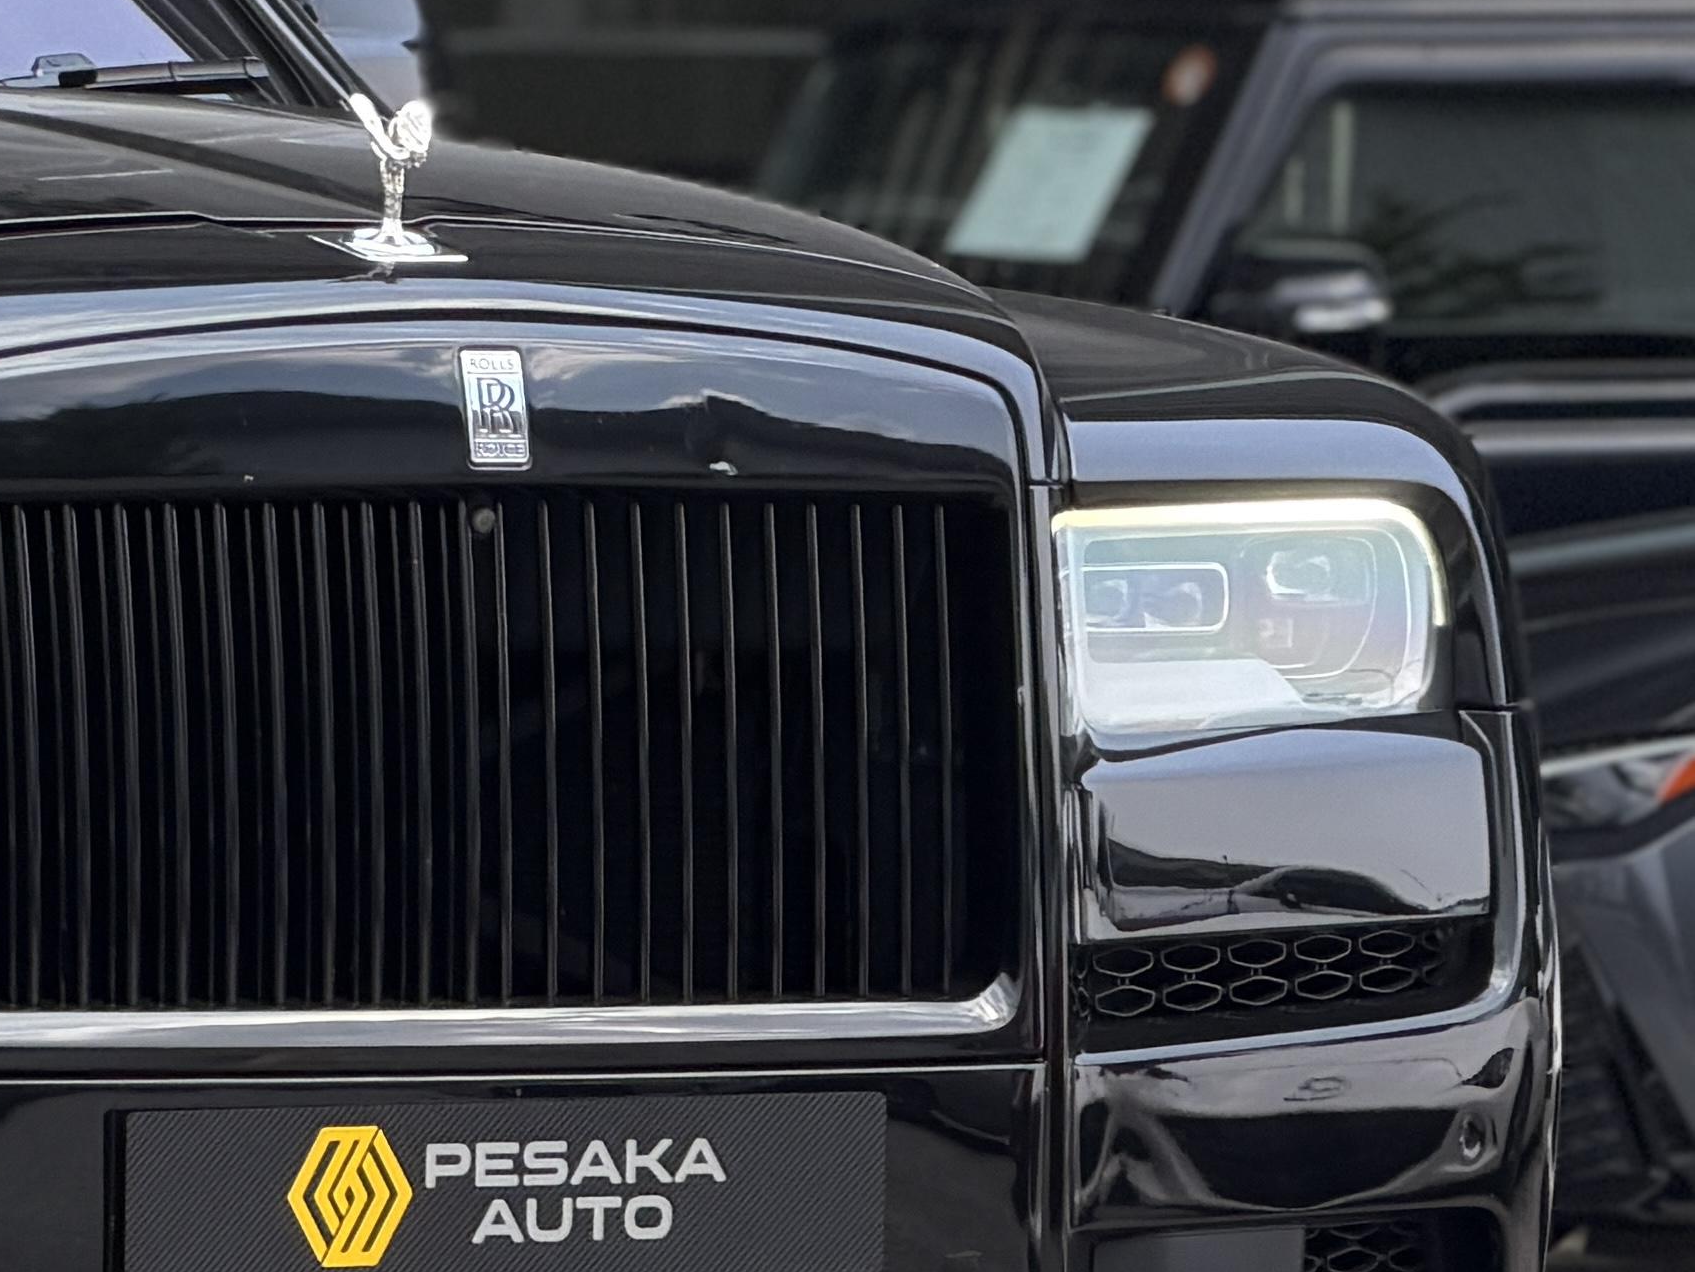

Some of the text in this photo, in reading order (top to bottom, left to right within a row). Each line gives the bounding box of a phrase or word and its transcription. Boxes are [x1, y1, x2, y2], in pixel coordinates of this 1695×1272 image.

[470, 358, 515, 370] ROLLS
[424, 1138, 727, 1189] PESAKA
[471, 1195, 674, 1245] AUTO
